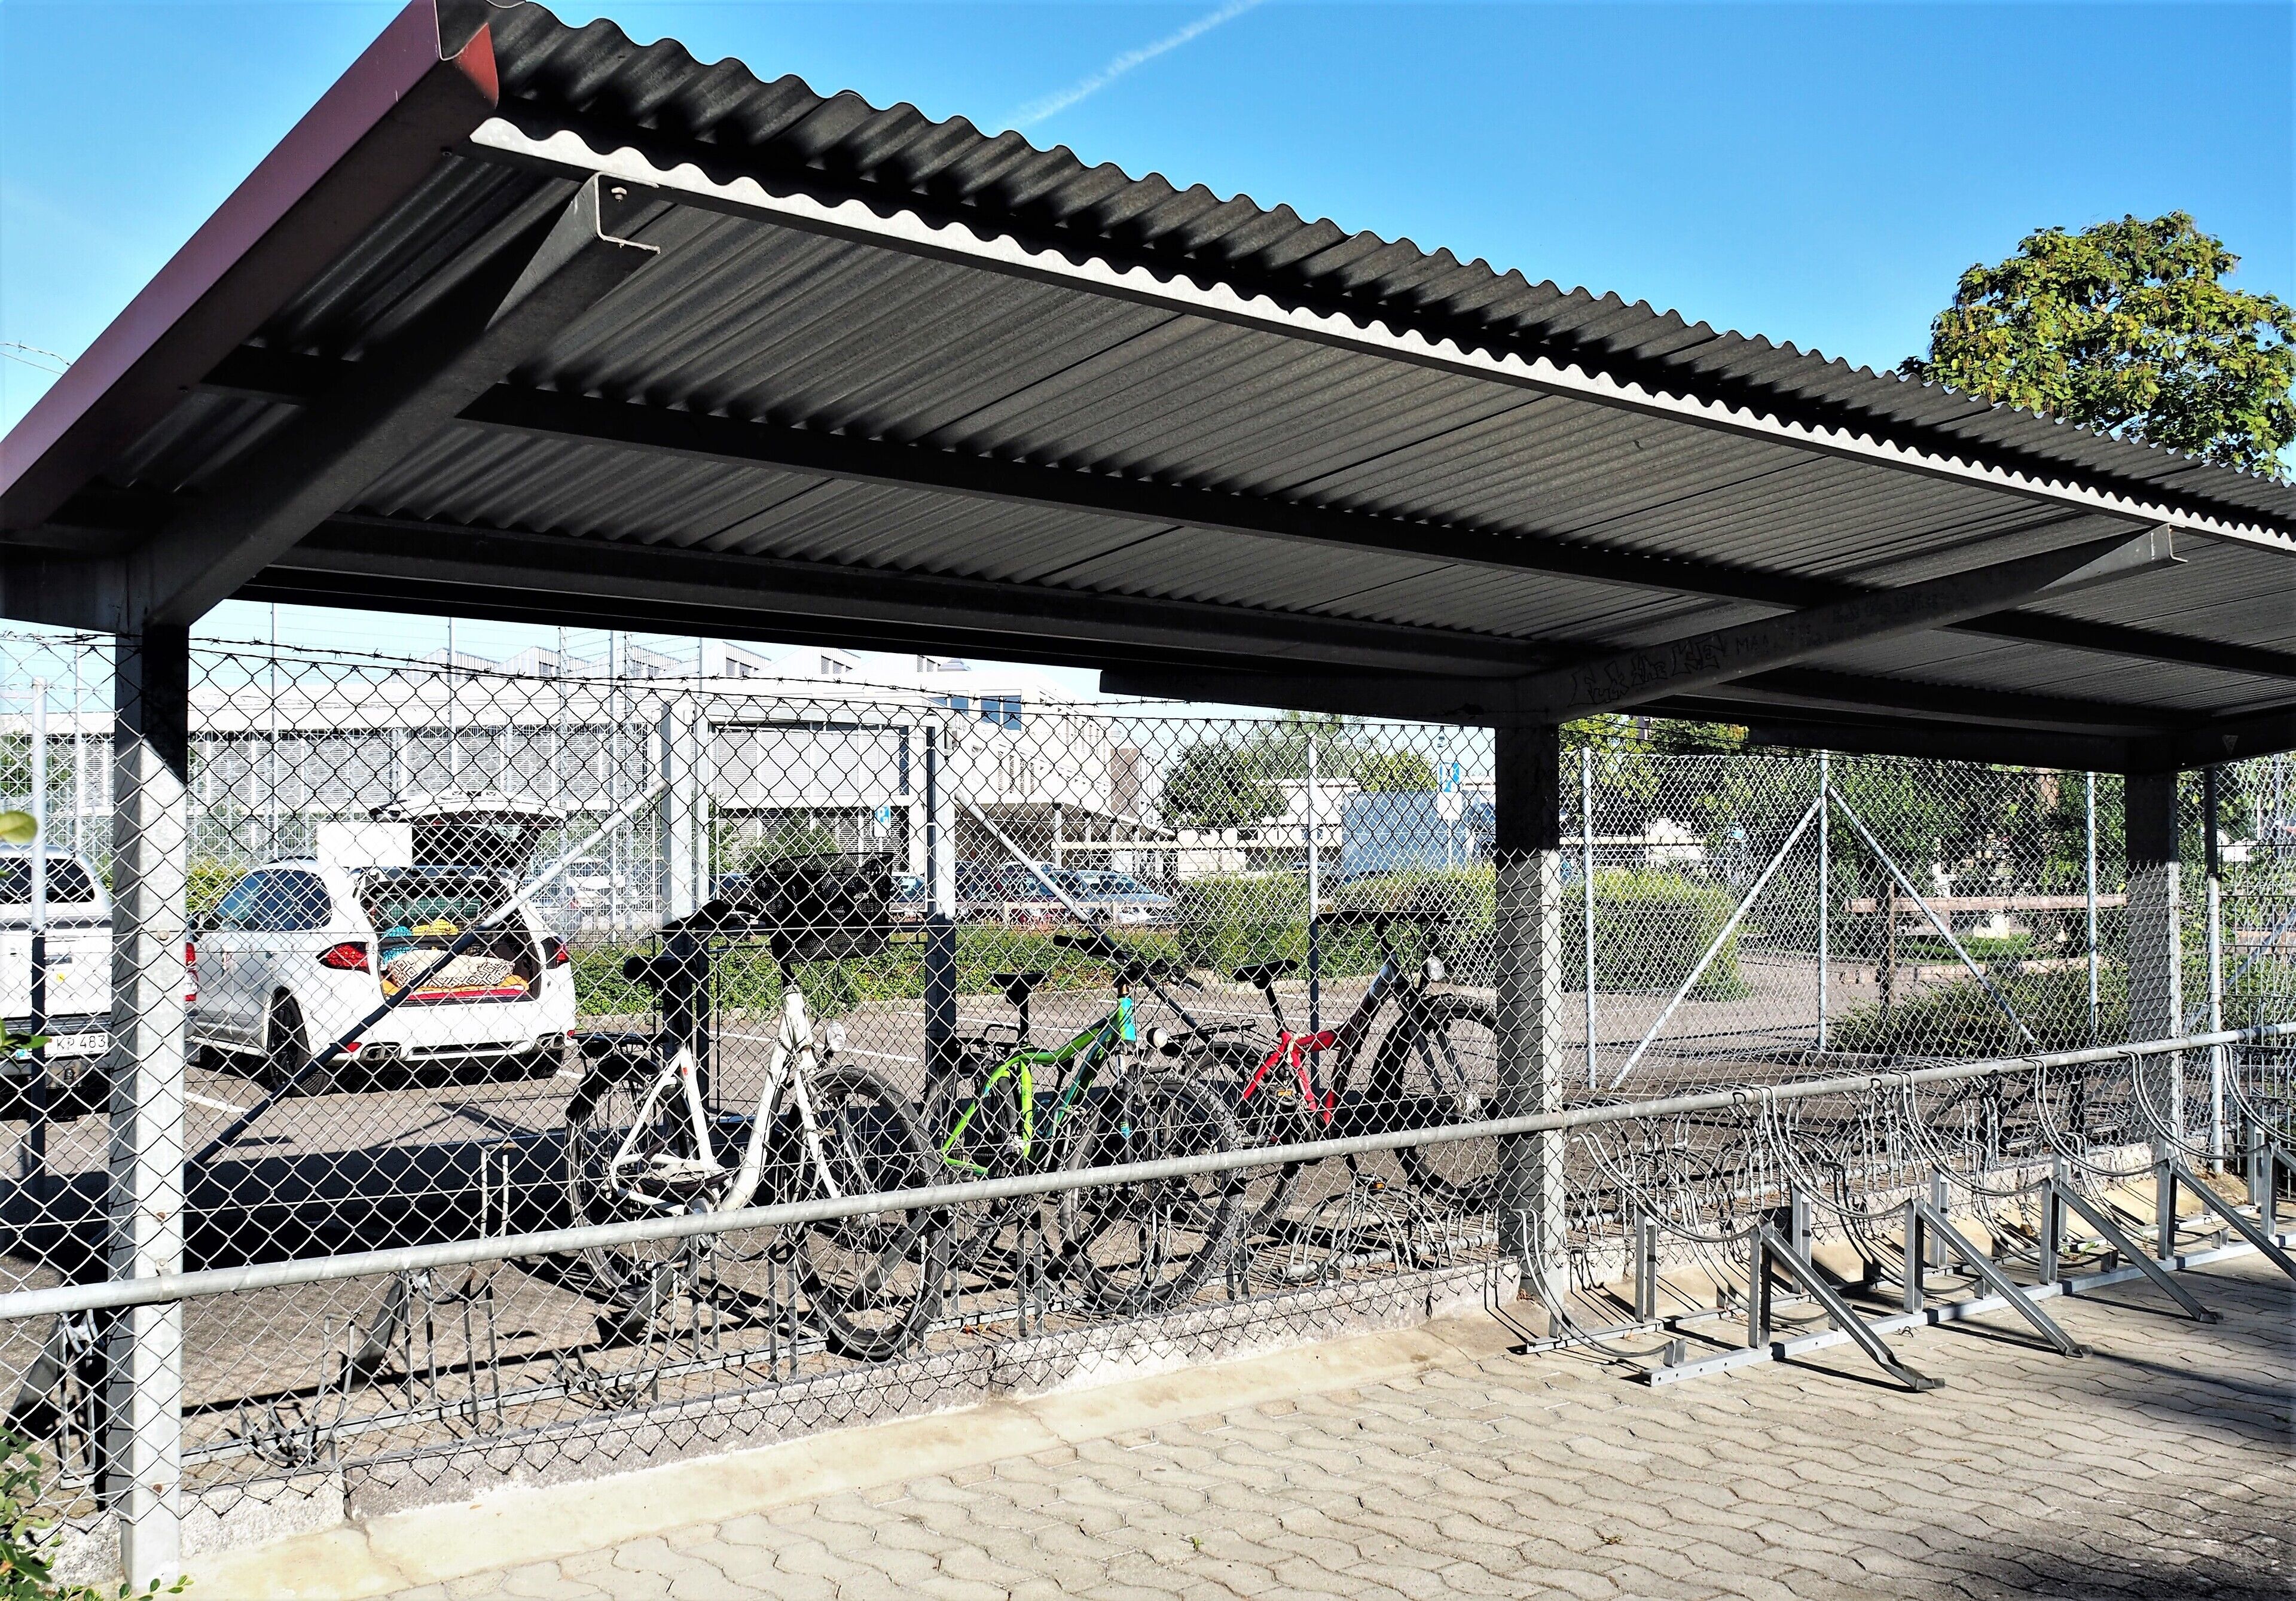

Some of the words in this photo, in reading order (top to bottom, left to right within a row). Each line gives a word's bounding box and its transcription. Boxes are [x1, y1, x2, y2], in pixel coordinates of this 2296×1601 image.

[877, 807, 886, 822] P
[57, 1037, 75, 1050] KP
[80, 1035, 105, 1048] 483
